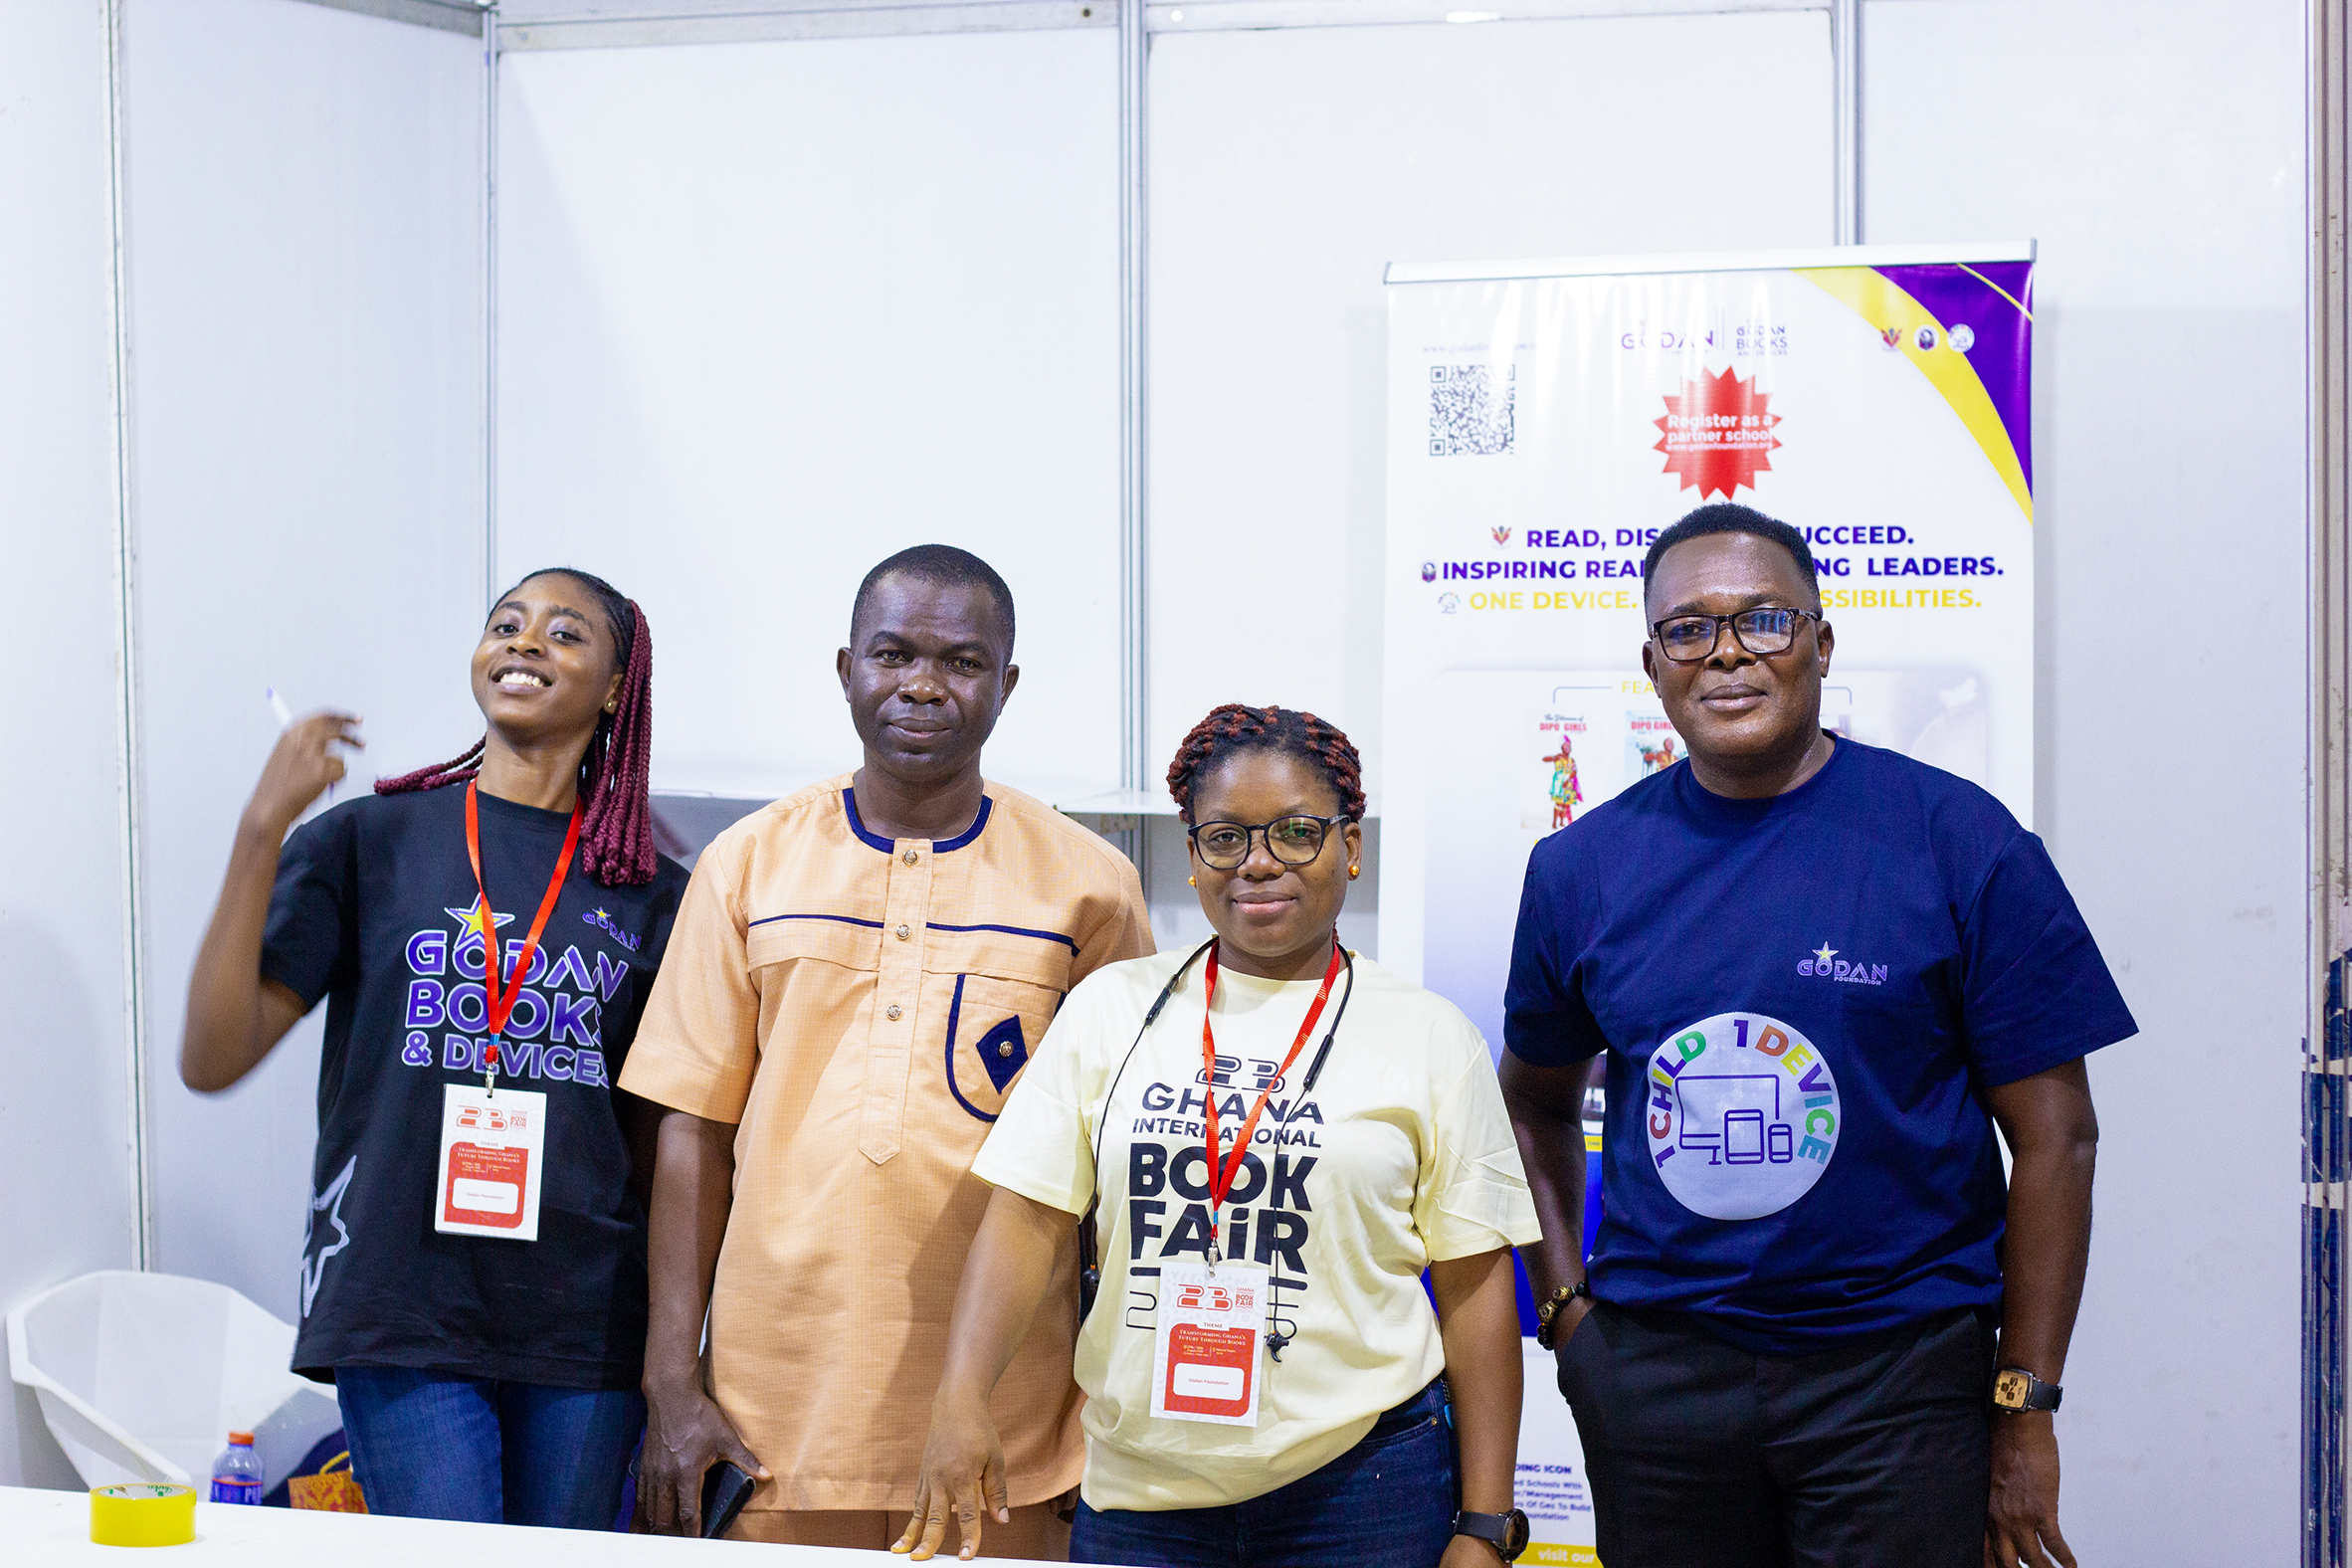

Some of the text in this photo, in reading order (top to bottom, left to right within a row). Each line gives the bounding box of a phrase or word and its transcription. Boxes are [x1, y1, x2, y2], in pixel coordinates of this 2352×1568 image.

[1666, 413, 1773, 429] Register as a
[1666, 427, 1773, 444] partner school
[1527, 529, 1607, 550] READ,
[1795, 525, 1914, 545] UCCEED.
[1443, 560, 1576, 580] INSPIRING
[1867, 556, 2005, 576] LEADERS.
[1469, 588, 1983, 610] ONE DEVICE. SSIBILITIES.
[1539, 722, 1588, 732] DIPO GIRLS
[1631, 720, 1652, 730] DIPO
[582, 911, 643, 950] GODAN
[405, 928, 630, 1003] GODAN
[1796, 958, 1888, 982] GODAN
[1833, 975, 1882, 986] FOUNDATION
[401, 1030, 433, 1068] &
[1141, 1081, 1325, 1125] GHANA
[1649, 1030, 1707, 1140] CHILD
[1733, 1019, 1749, 1048] 1
[1754, 1024, 1837, 1165] DEVICE
[1129, 1142, 1318, 1212] BOOK
[1544, 1465, 1572, 1474] ICON
[1526, 1479, 1561, 1488] Schools
[1570, 1503, 1592, 1512] Build
[1537, 1549, 1596, 1563] visit our
